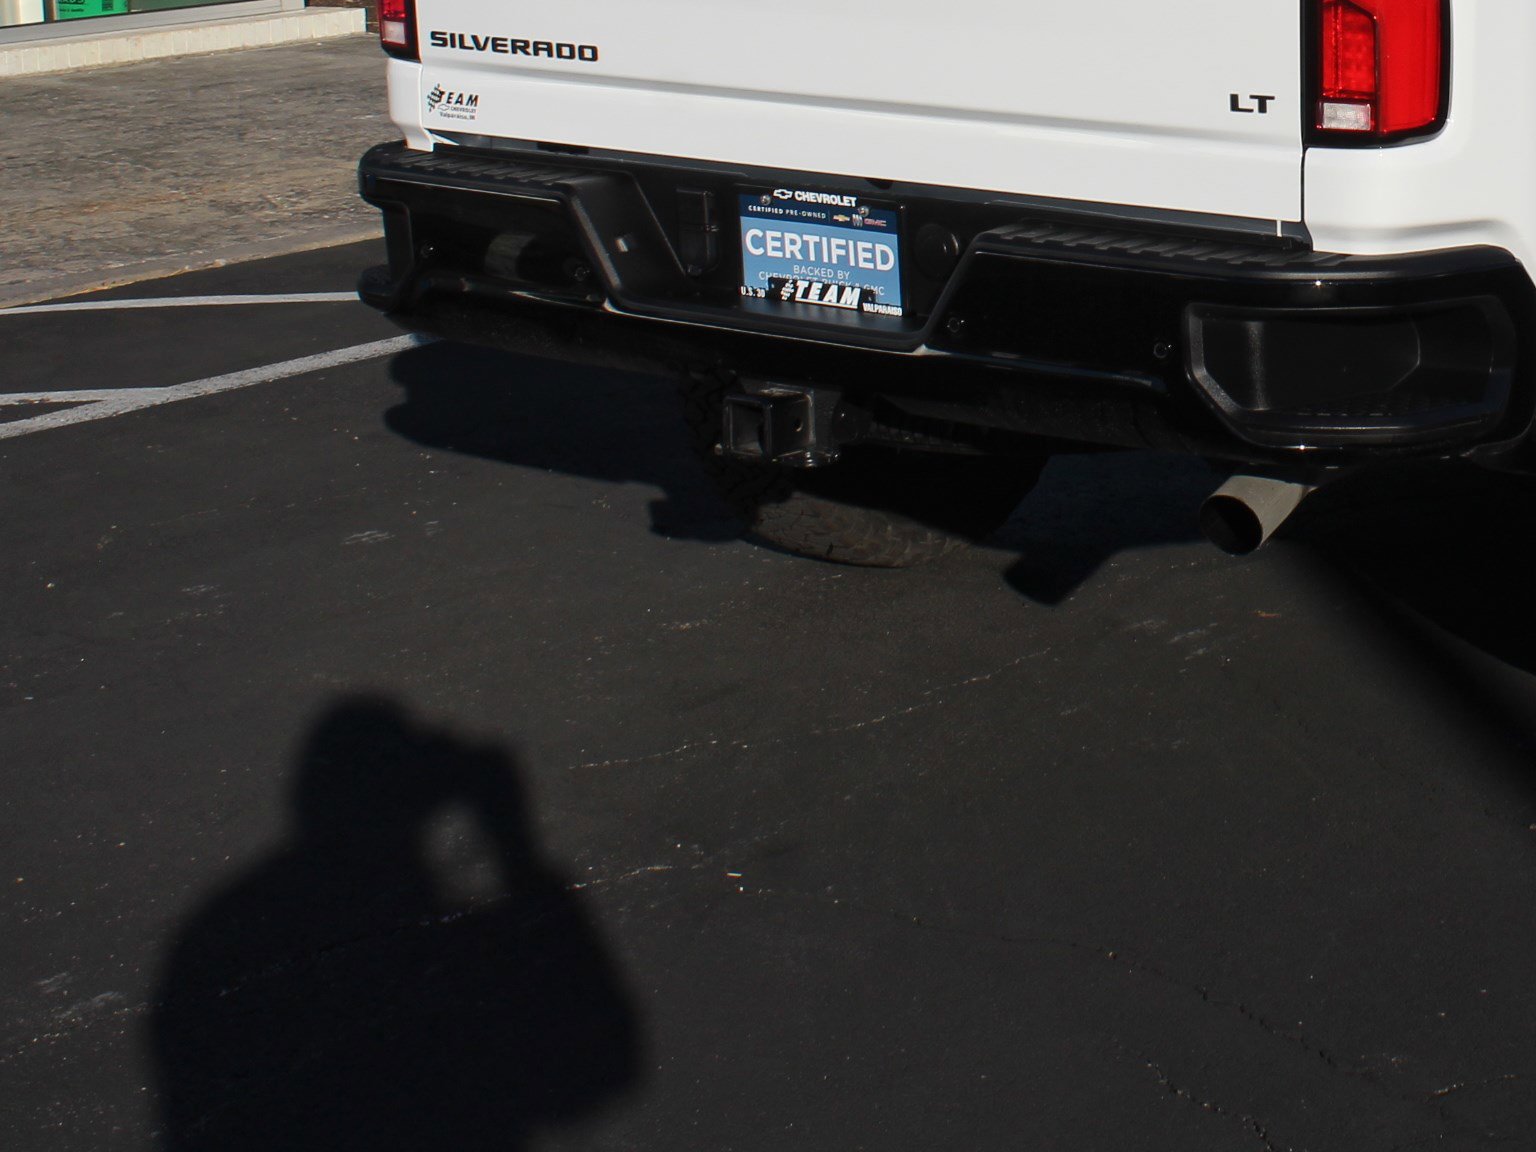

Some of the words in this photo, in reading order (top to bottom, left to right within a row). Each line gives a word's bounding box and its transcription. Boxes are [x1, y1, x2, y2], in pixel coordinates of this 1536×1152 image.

[430, 30, 598, 62] SILVERADO
[1229, 93, 1275, 114] LT
[794, 190, 857, 208] CHEVROLET
[748, 205, 784, 216] CERTIFIED
[785, 209, 826, 219] PRE-OWNED
[745, 228, 895, 271] CERTIFIED
[793, 264, 834, 279] BACKED
[837, 269, 850, 280] BY
[795, 280, 861, 308] TEAM
[863, 302, 902, 316] VALPARAISO
